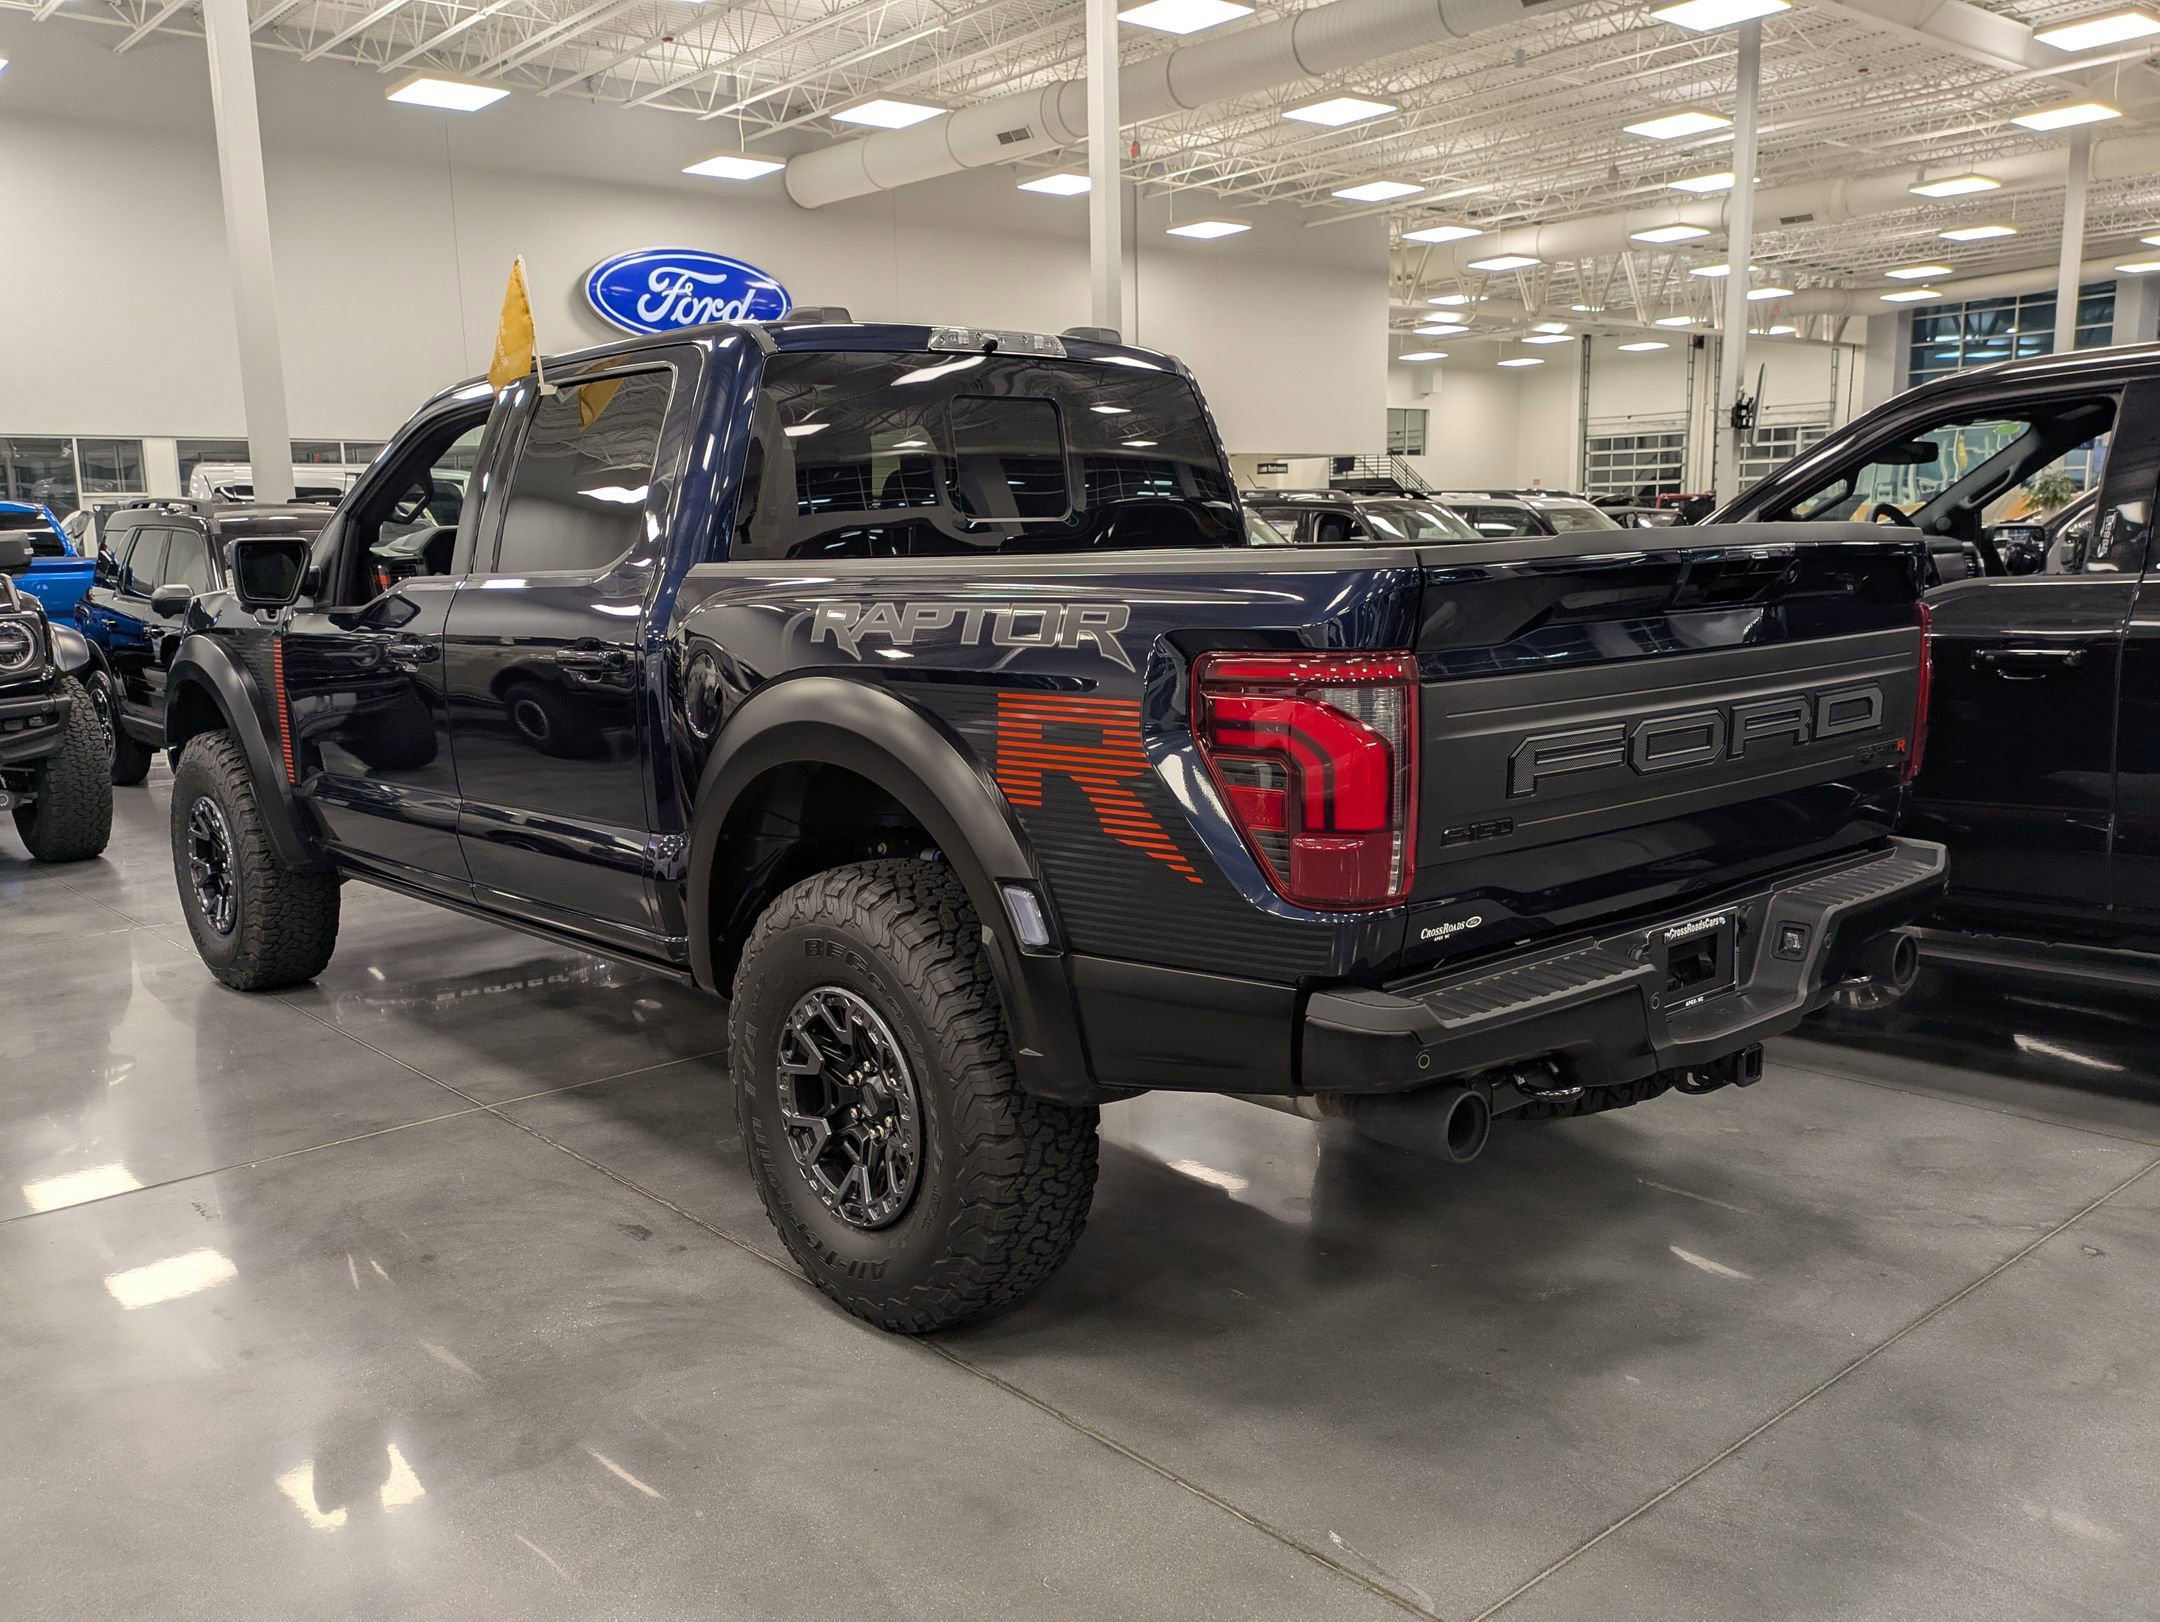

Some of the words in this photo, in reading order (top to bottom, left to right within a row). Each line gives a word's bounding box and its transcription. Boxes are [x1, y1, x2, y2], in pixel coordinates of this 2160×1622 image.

[637, 266, 757, 324] Ford
[810, 601, 1137, 673] RAPTOR
[1505, 683, 1885, 798] FORD
